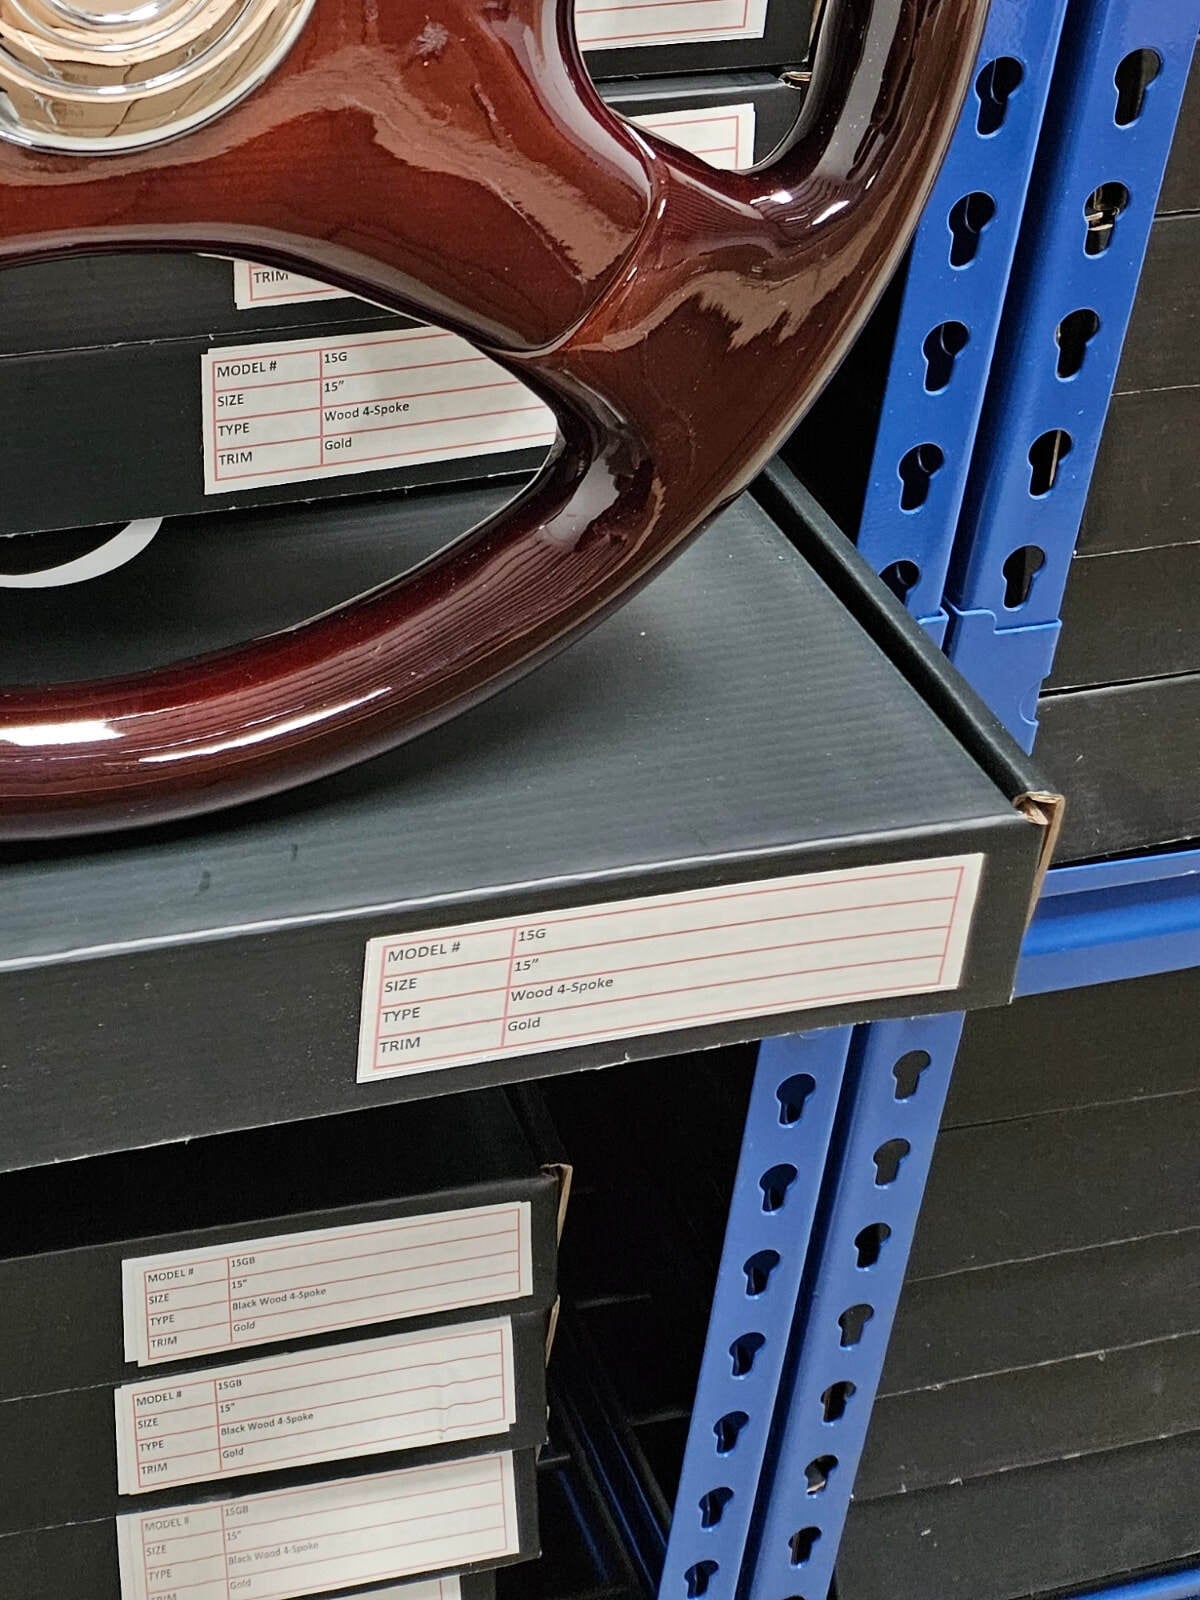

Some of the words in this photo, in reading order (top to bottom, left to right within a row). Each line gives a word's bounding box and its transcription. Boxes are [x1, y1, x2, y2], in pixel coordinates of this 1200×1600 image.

[217, 361, 266, 378] MODEL
[269, 361, 277, 371] #
[324, 352, 348, 364] 15G
[218, 393, 244, 407] SIZE
[218, 423, 250, 436] TYPE
[324, 406, 359, 422] Wood
[362, 401, 410, 417] 4-Spoke
[219, 451, 253, 466] TRIM
[324, 438, 352, 450] Gold
[388, 944, 447, 962] MODEL
[451, 942, 461, 953] #
[518, 929, 546, 942] 15G
[385, 978, 417, 993] SIZE
[383, 1007, 421, 1023] TYPE
[511, 985, 553, 1001] Wood
[557, 977, 614, 995] 4-Spoke
[380, 1037, 421, 1053] TRIM
[508, 1017, 541, 1032] Gold
[147, 1269, 186, 1282] MODEL
[188, 1267, 194, 1276] #
[232, 1256, 255, 1268] 15GB
[148, 1293, 169, 1305] SIZE
[150, 1314, 175, 1326] TYPE
[232, 1298, 256, 1311] Black
[260, 1294, 287, 1306] Wood
[289, 1288, 327, 1301] 4-Spoke
[151, 1336, 178, 1348] TRIM
[234, 1321, 255, 1332] Gold
[136, 1392, 174, 1407] MODEL
[176, 1390, 182, 1399] #
[218, 1379, 242, 1390] 15GB
[138, 1417, 159, 1429] SIZE
[140, 1440, 164, 1452] TYPE
[221, 1424, 245, 1436] Black
[248, 1418, 275, 1431] Wood
[277, 1412, 314, 1425] 4-Spoke
[141, 1462, 168, 1475] TRIM
[222, 1448, 244, 1459] Gold
